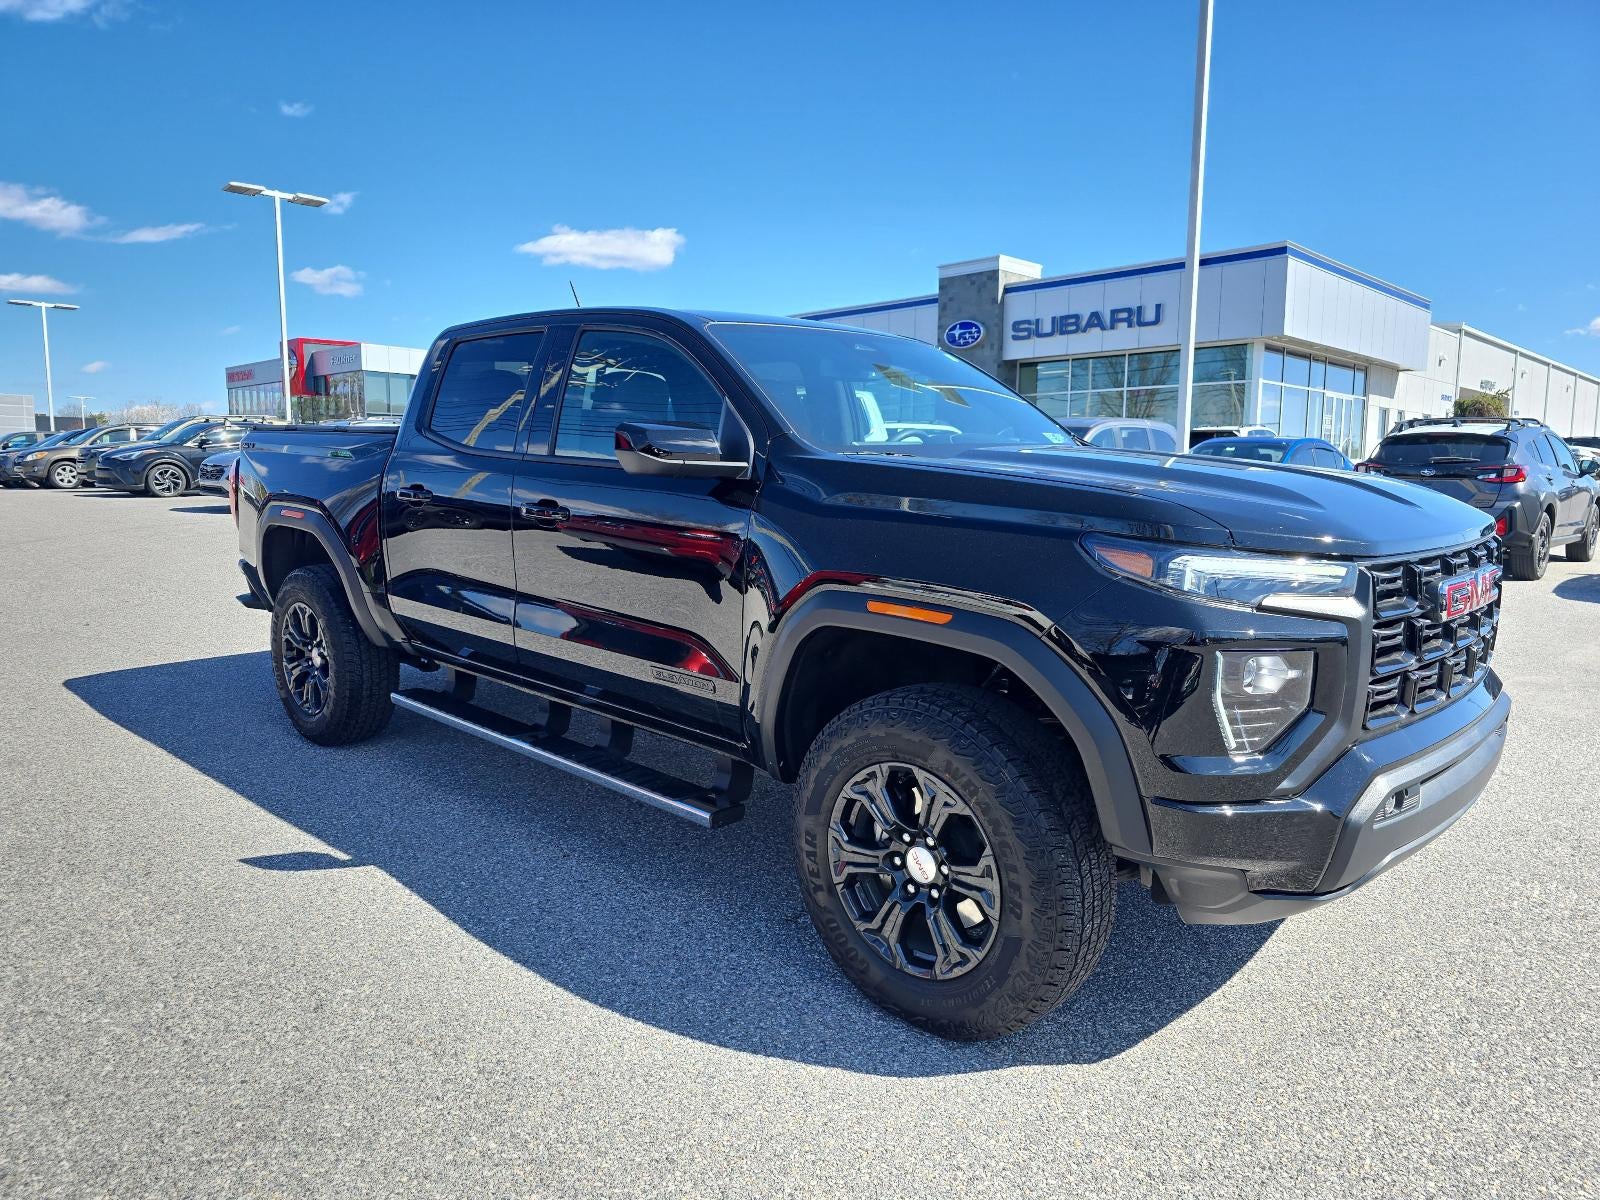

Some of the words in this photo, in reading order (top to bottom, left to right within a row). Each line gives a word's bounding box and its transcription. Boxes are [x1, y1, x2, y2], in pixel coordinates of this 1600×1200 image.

[1011, 304, 1161, 341] SUBARU
[1446, 568, 1501, 618] GMC
[911, 851, 929, 880] GMC
